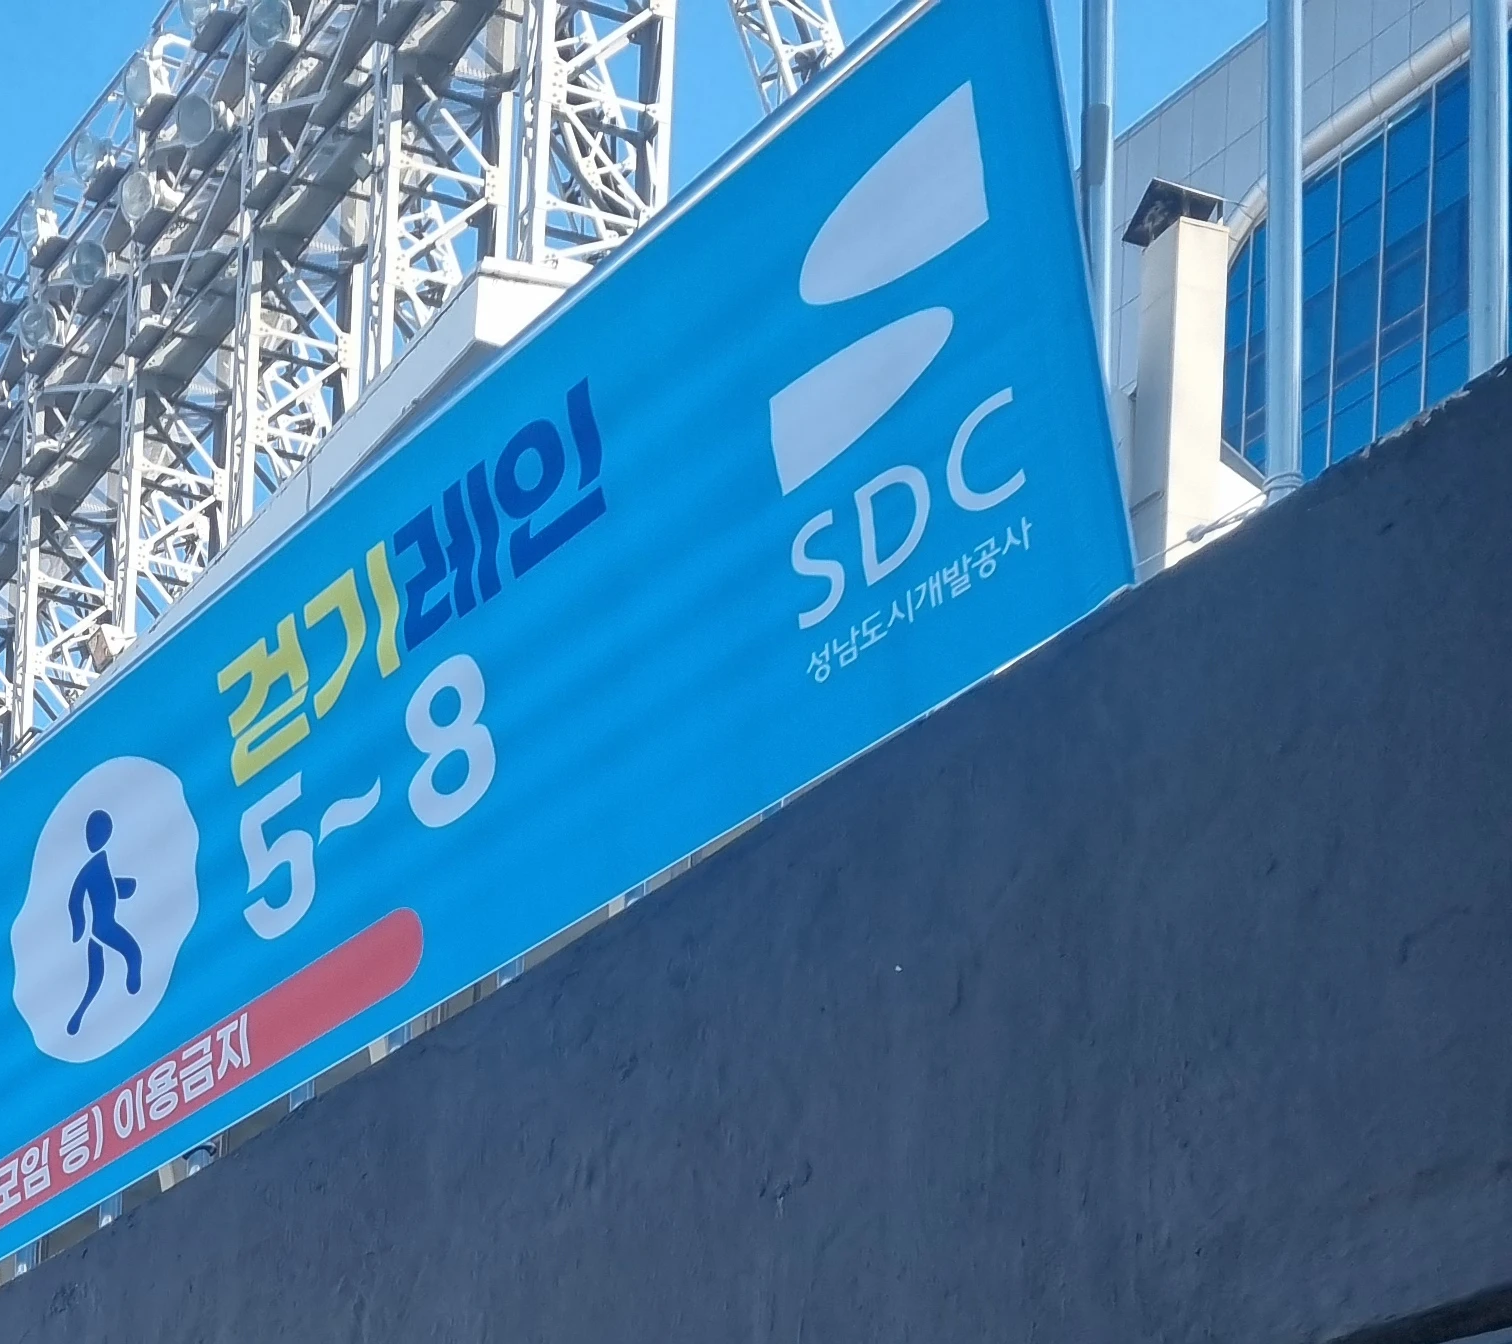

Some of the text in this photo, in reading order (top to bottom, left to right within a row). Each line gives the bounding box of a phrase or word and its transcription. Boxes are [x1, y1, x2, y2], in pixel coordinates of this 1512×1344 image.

[216, 376, 608, 787] 걷기레인
[789, 387, 1027, 630] SDC
[806, 516, 1034, 683] 성남도시개발공사
[58, 1104, 104, 1174] 등)
[113, 1012, 252, 1140] 이용금지
